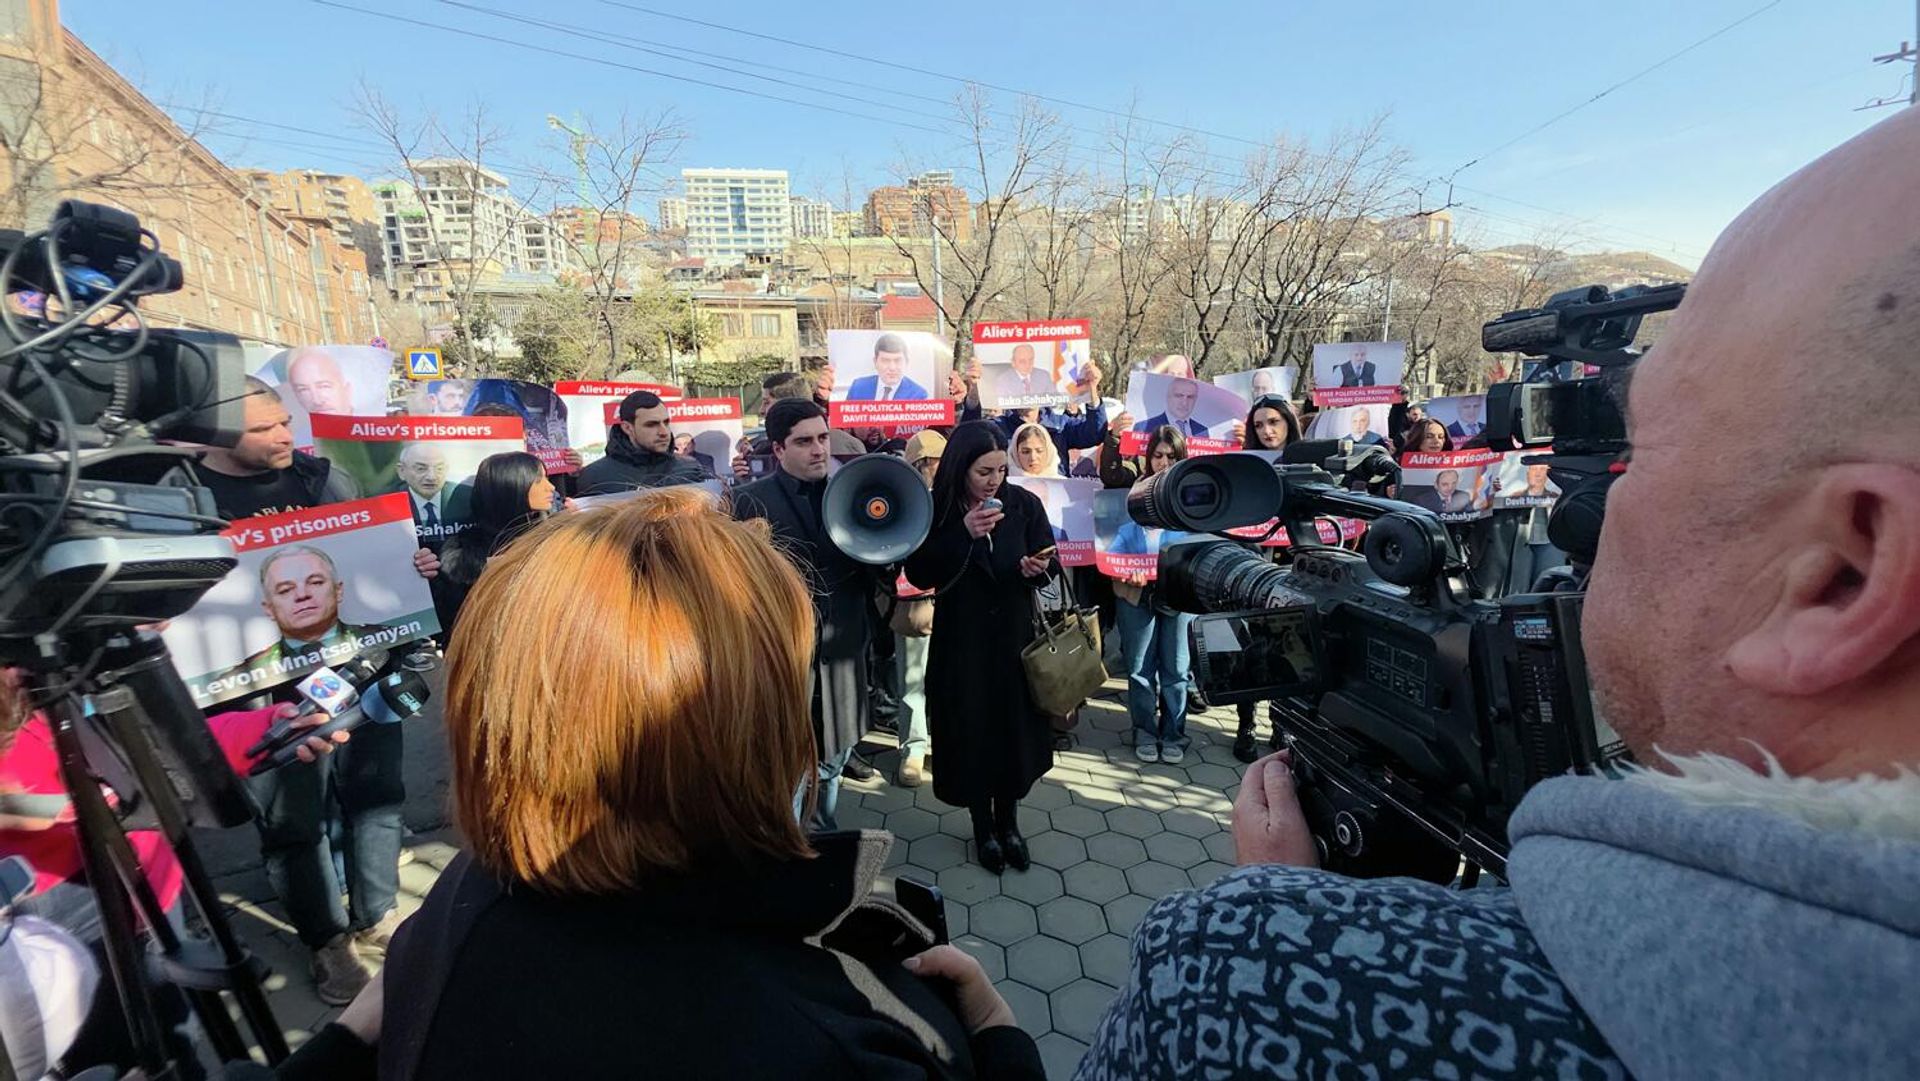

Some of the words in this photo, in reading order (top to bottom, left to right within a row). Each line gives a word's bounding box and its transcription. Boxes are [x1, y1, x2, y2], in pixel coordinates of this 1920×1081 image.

[981, 325, 1024, 338] Aliev's
[1026, 324, 1083, 339] prisoners
[578, 385, 612, 395] Aliev's
[667, 403, 733, 417] prisoners
[840, 404, 859, 412] FREE
[861, 403, 904, 412] POLITICAL
[905, 403, 945, 411] PRISONER
[843, 414, 868, 422] DAVIT
[869, 413, 945, 422] HAMBARDZUMYAN
[351, 422, 410, 437] Aliev's
[414, 424, 492, 438] prisoners
[1408, 454, 1450, 465] Aliev's
[270, 510, 371, 544] prisoners
[1127, 557, 1157, 566] POLITI
[191, 665, 268, 700] Levon
[273, 619, 422, 676] Mnatsakanyan
